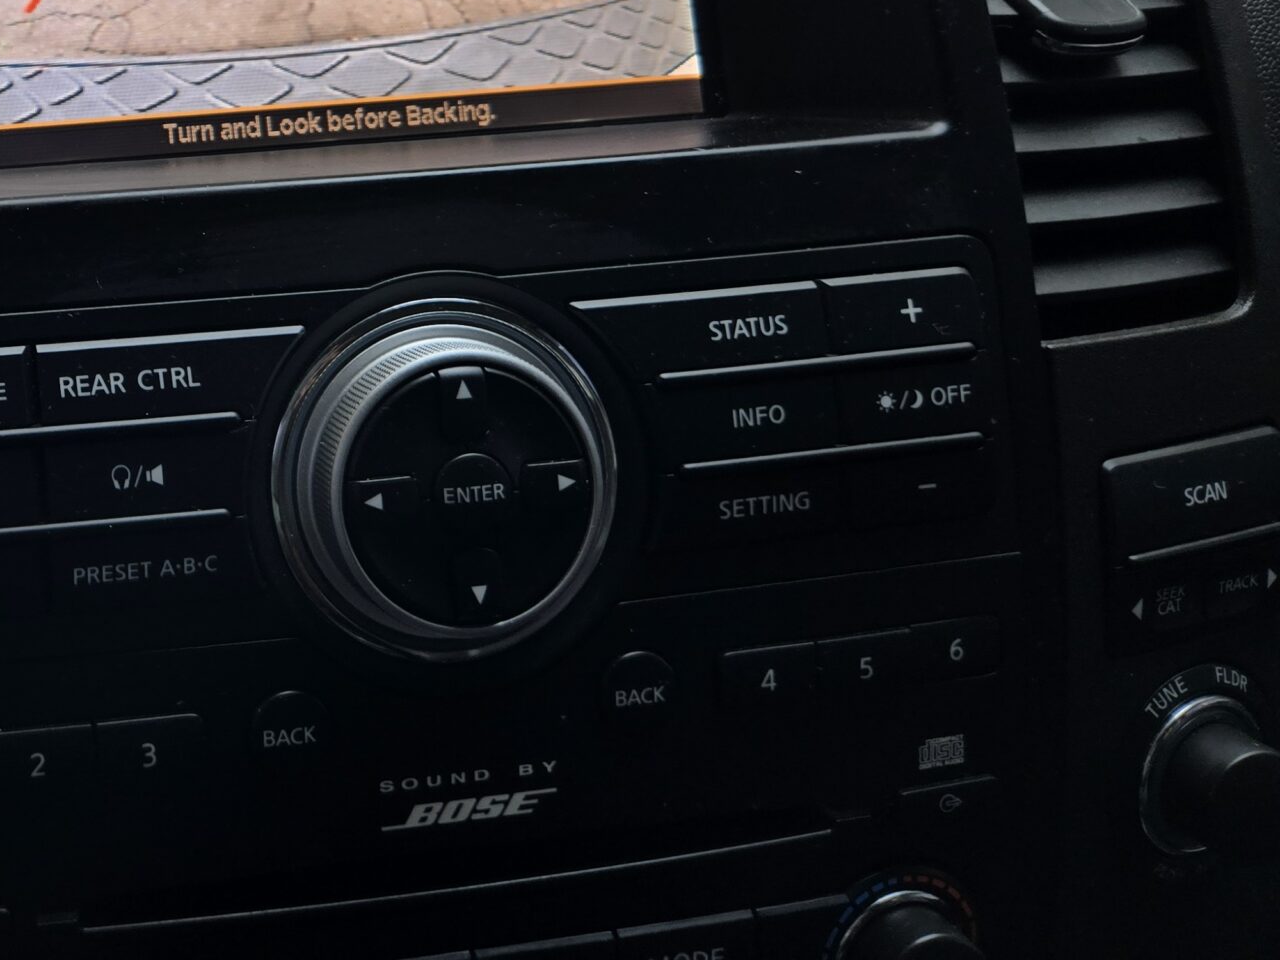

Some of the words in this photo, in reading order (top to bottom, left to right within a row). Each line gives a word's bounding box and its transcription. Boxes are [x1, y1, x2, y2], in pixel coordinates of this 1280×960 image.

[163, 121, 215, 144] Turn
[220, 115, 261, 140] and
[266, 111, 321, 137] Look
[327, 106, 401, 132] before
[406, 99, 496, 126] Backing.
[708, 314, 789, 341] STATUS
[58, 372, 126, 398] REAR
[137, 366, 201, 390] CTRL
[930, 384, 972, 407] OFF
[732, 404, 786, 428] INFO
[443, 483, 505, 504] ENTER
[719, 491, 811, 520] SETTING
[1184, 481, 1229, 507] SCAN
[73, 560, 153, 586] PRESET
[1219, 575, 1260, 594] TRACK
[1157, 597, 1183, 616] CAT
[949, 639, 964, 661] 6
[761, 669, 777, 691] 4
[859, 657, 874, 679] 5
[1215, 665, 1249, 694] FLDR
[614, 685, 666, 708] BACK
[1144, 675, 1189, 719] TUNE
[262, 725, 317, 748] BACK
[29, 752, 47, 777] 2
[141, 743, 158, 767] 3
[378, 768, 490, 794] SOUND
[518, 759, 557, 777] BY
[380, 787, 559, 832] BOSE
